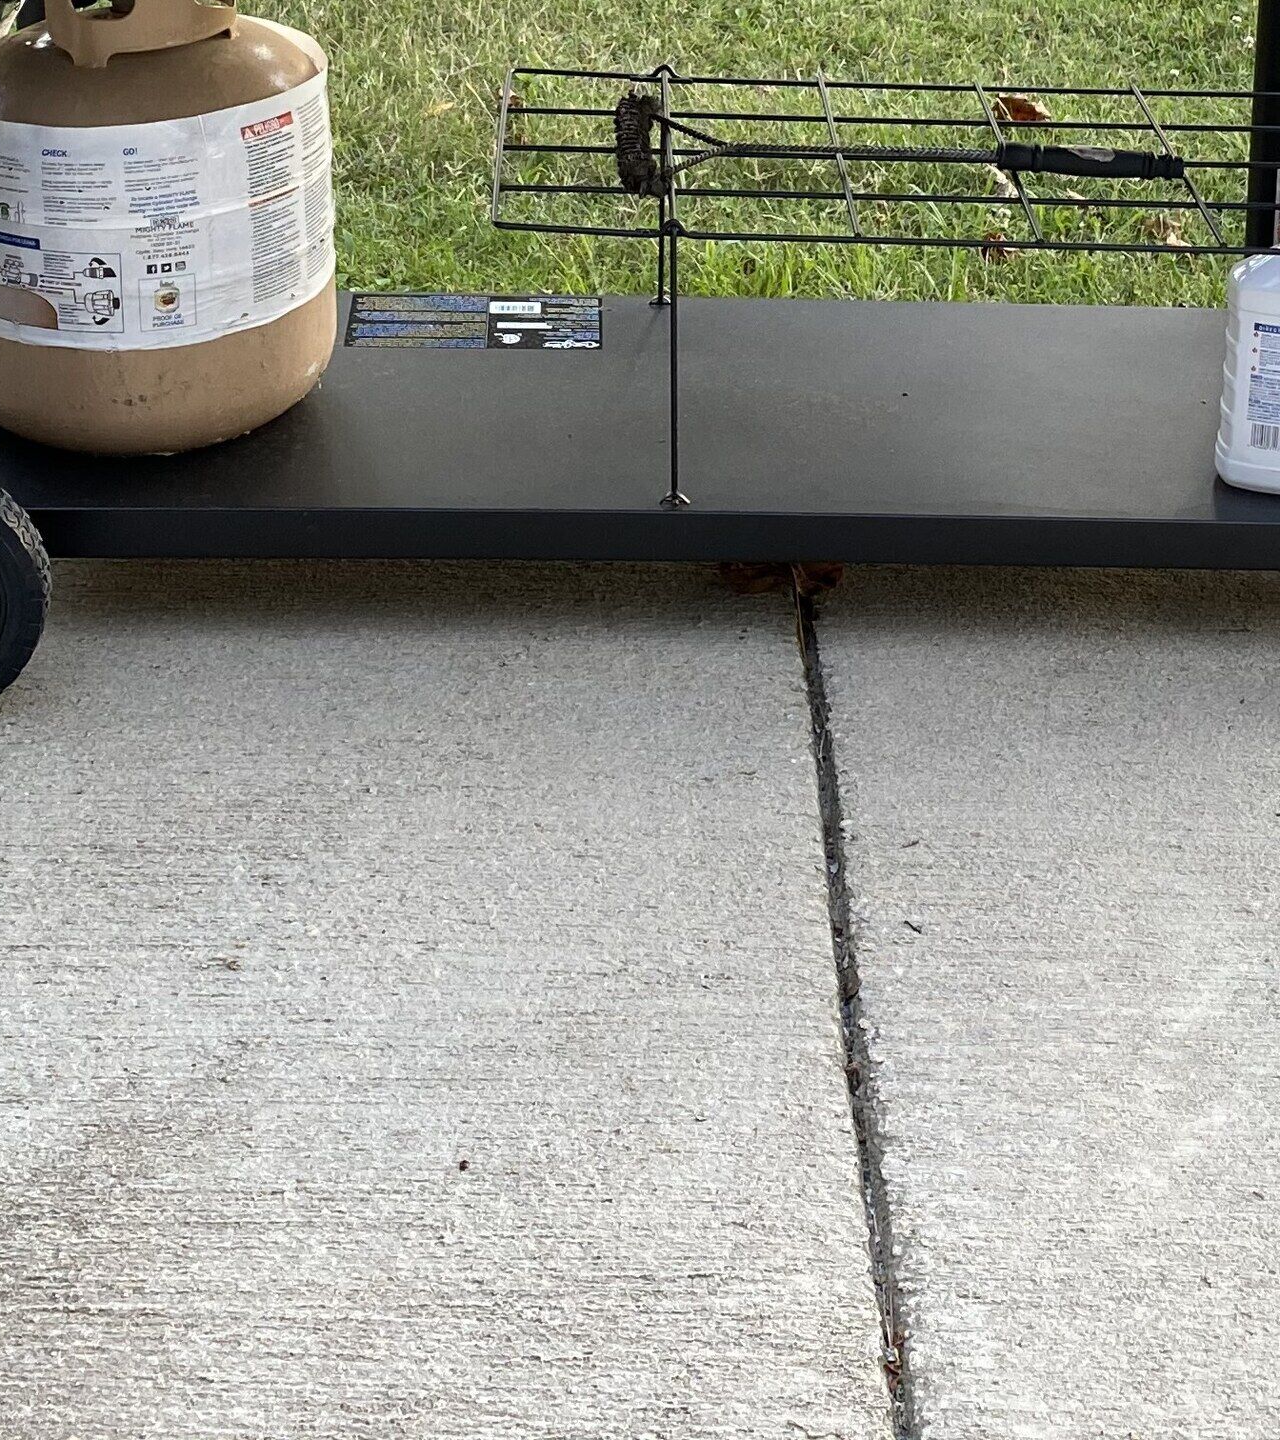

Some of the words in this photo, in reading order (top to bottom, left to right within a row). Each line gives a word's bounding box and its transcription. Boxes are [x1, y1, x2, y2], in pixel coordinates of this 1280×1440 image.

[123, 147, 138, 156] GO!
[135, 223, 166, 233] MIGHTY
[169, 221, 194, 230] FLAME
